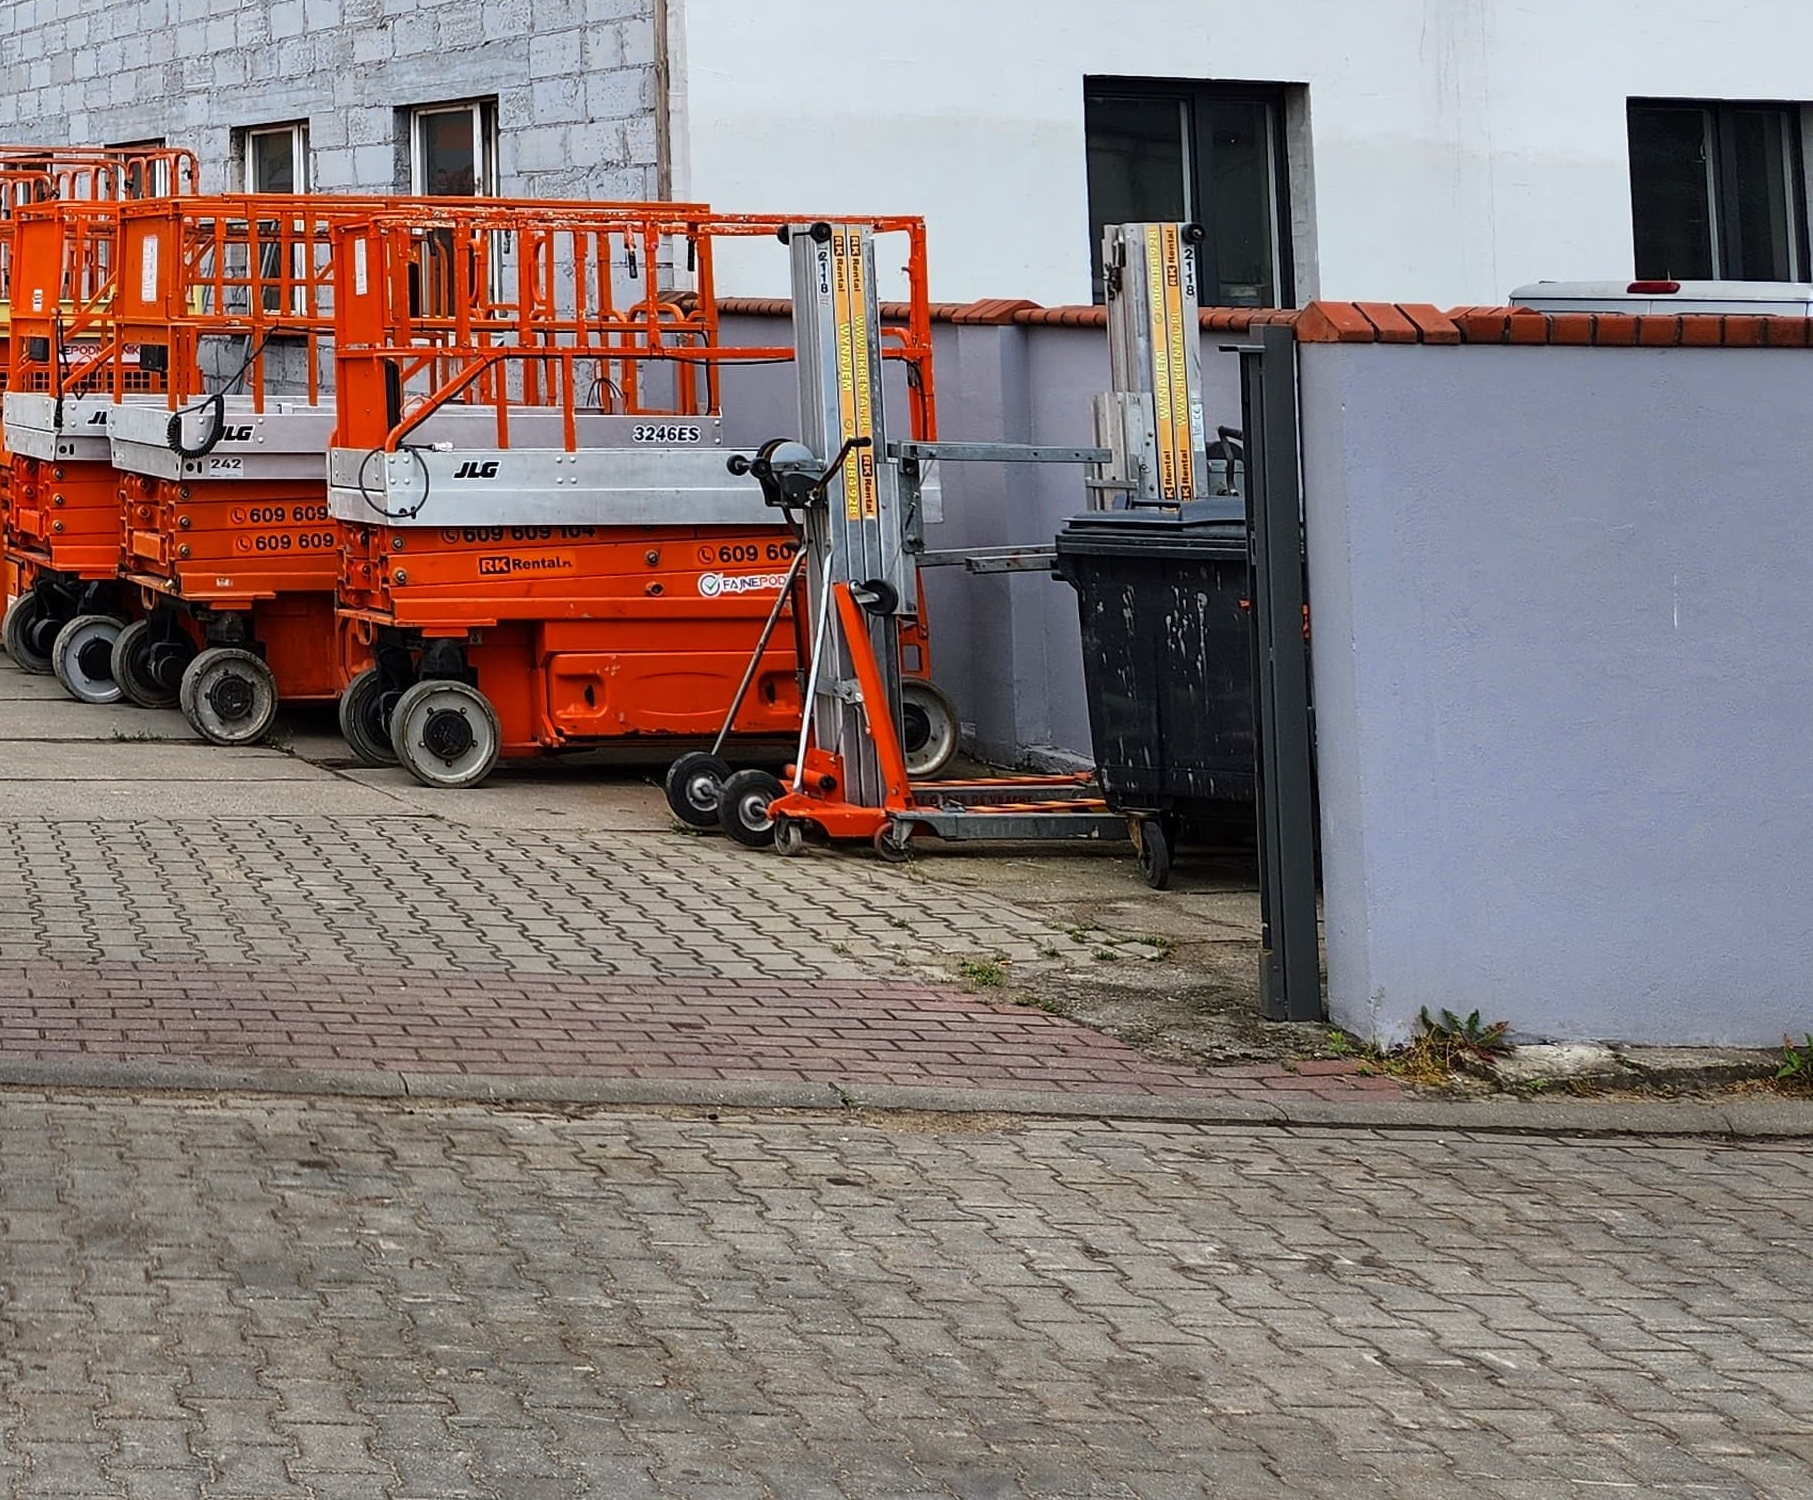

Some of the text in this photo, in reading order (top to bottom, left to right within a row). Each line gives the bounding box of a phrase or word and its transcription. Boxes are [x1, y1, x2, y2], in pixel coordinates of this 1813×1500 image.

[836, 258, 846, 293] Rental
[852, 258, 861, 293] Rental
[1184, 248, 1195, 296] 2118
[839, 323, 852, 391] WYNAJEM
[633, 426, 701, 442] 3246ES
[210, 458, 242, 469] 242
[453, 461, 499, 479] JLG
[249, 505, 328, 524] 609 609
[255, 532, 334, 551] 609 609
[719, 543, 792, 563] 609 60
[481, 559, 509, 573] RK
[723, 575, 787, 591] FAJNEPOD
